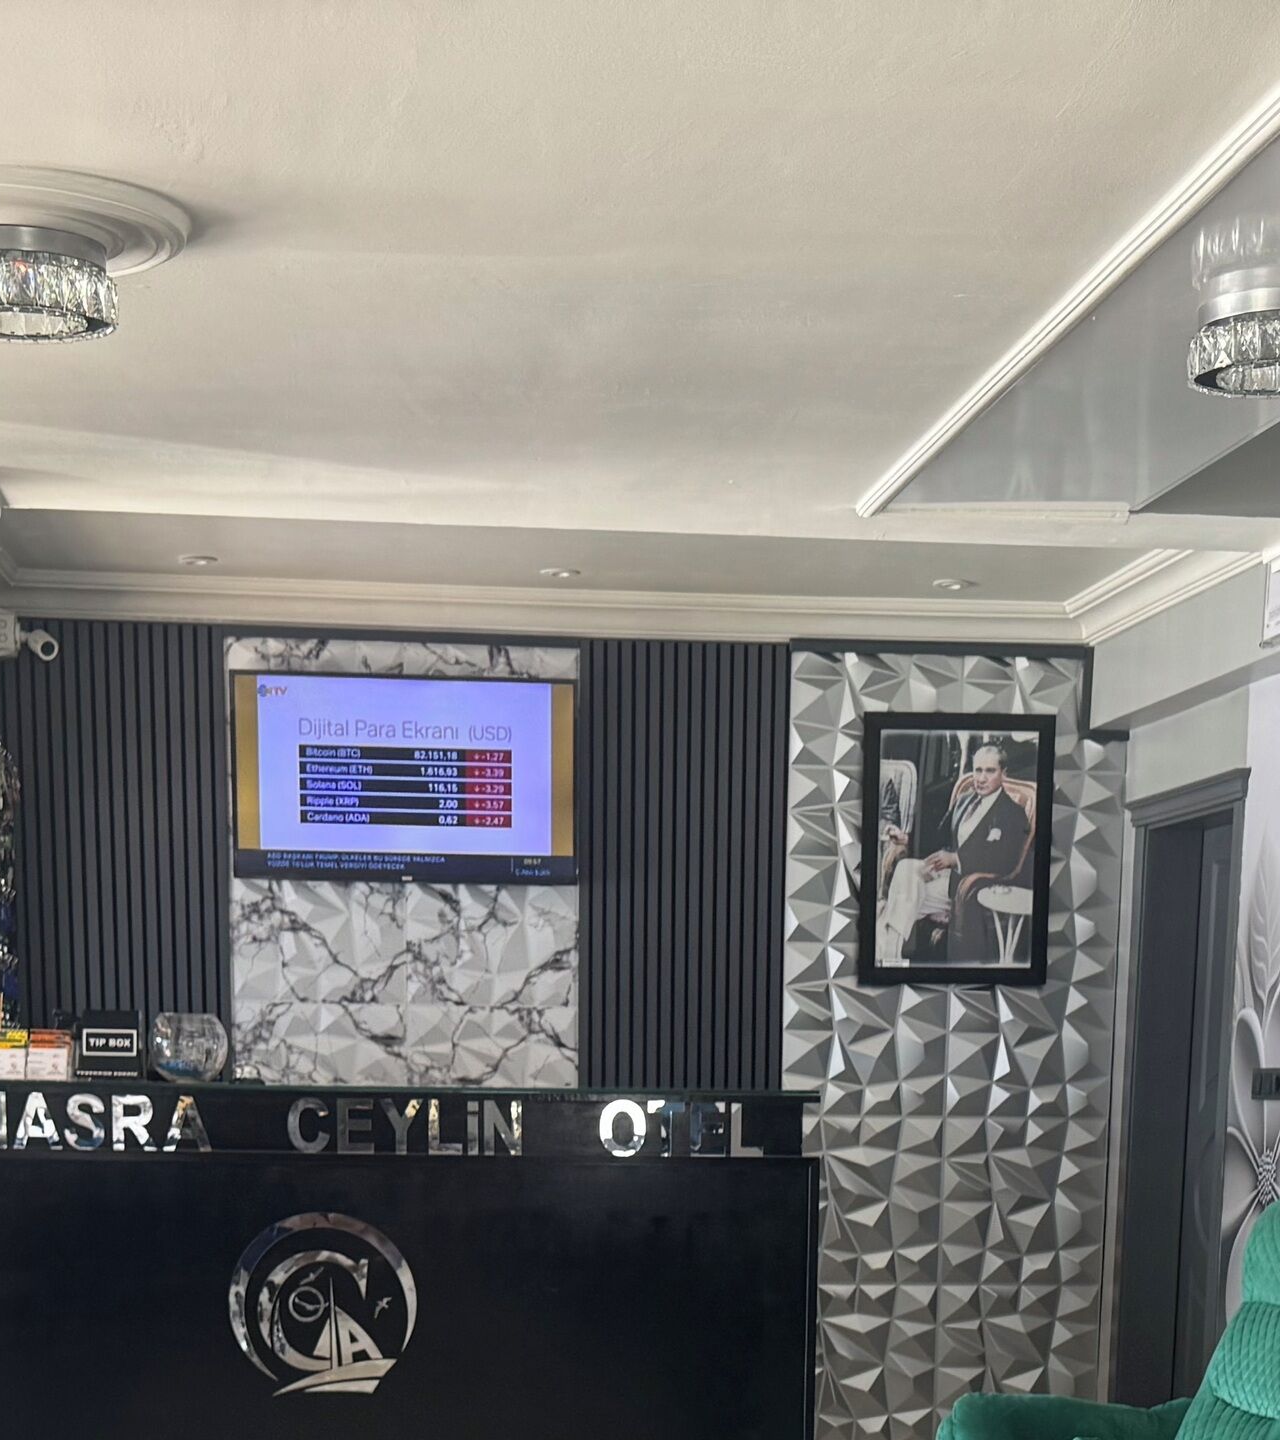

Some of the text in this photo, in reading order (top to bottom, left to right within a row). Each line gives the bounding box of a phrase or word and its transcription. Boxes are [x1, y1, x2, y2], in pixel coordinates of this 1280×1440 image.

[298, 718, 512, 742] Dijital Para Ekranı (USD)
[345, 813, 370, 823] (ADA)
[89, 1038, 131, 1048] TIP BOX
[599, 1099, 763, 1158] OTEL
